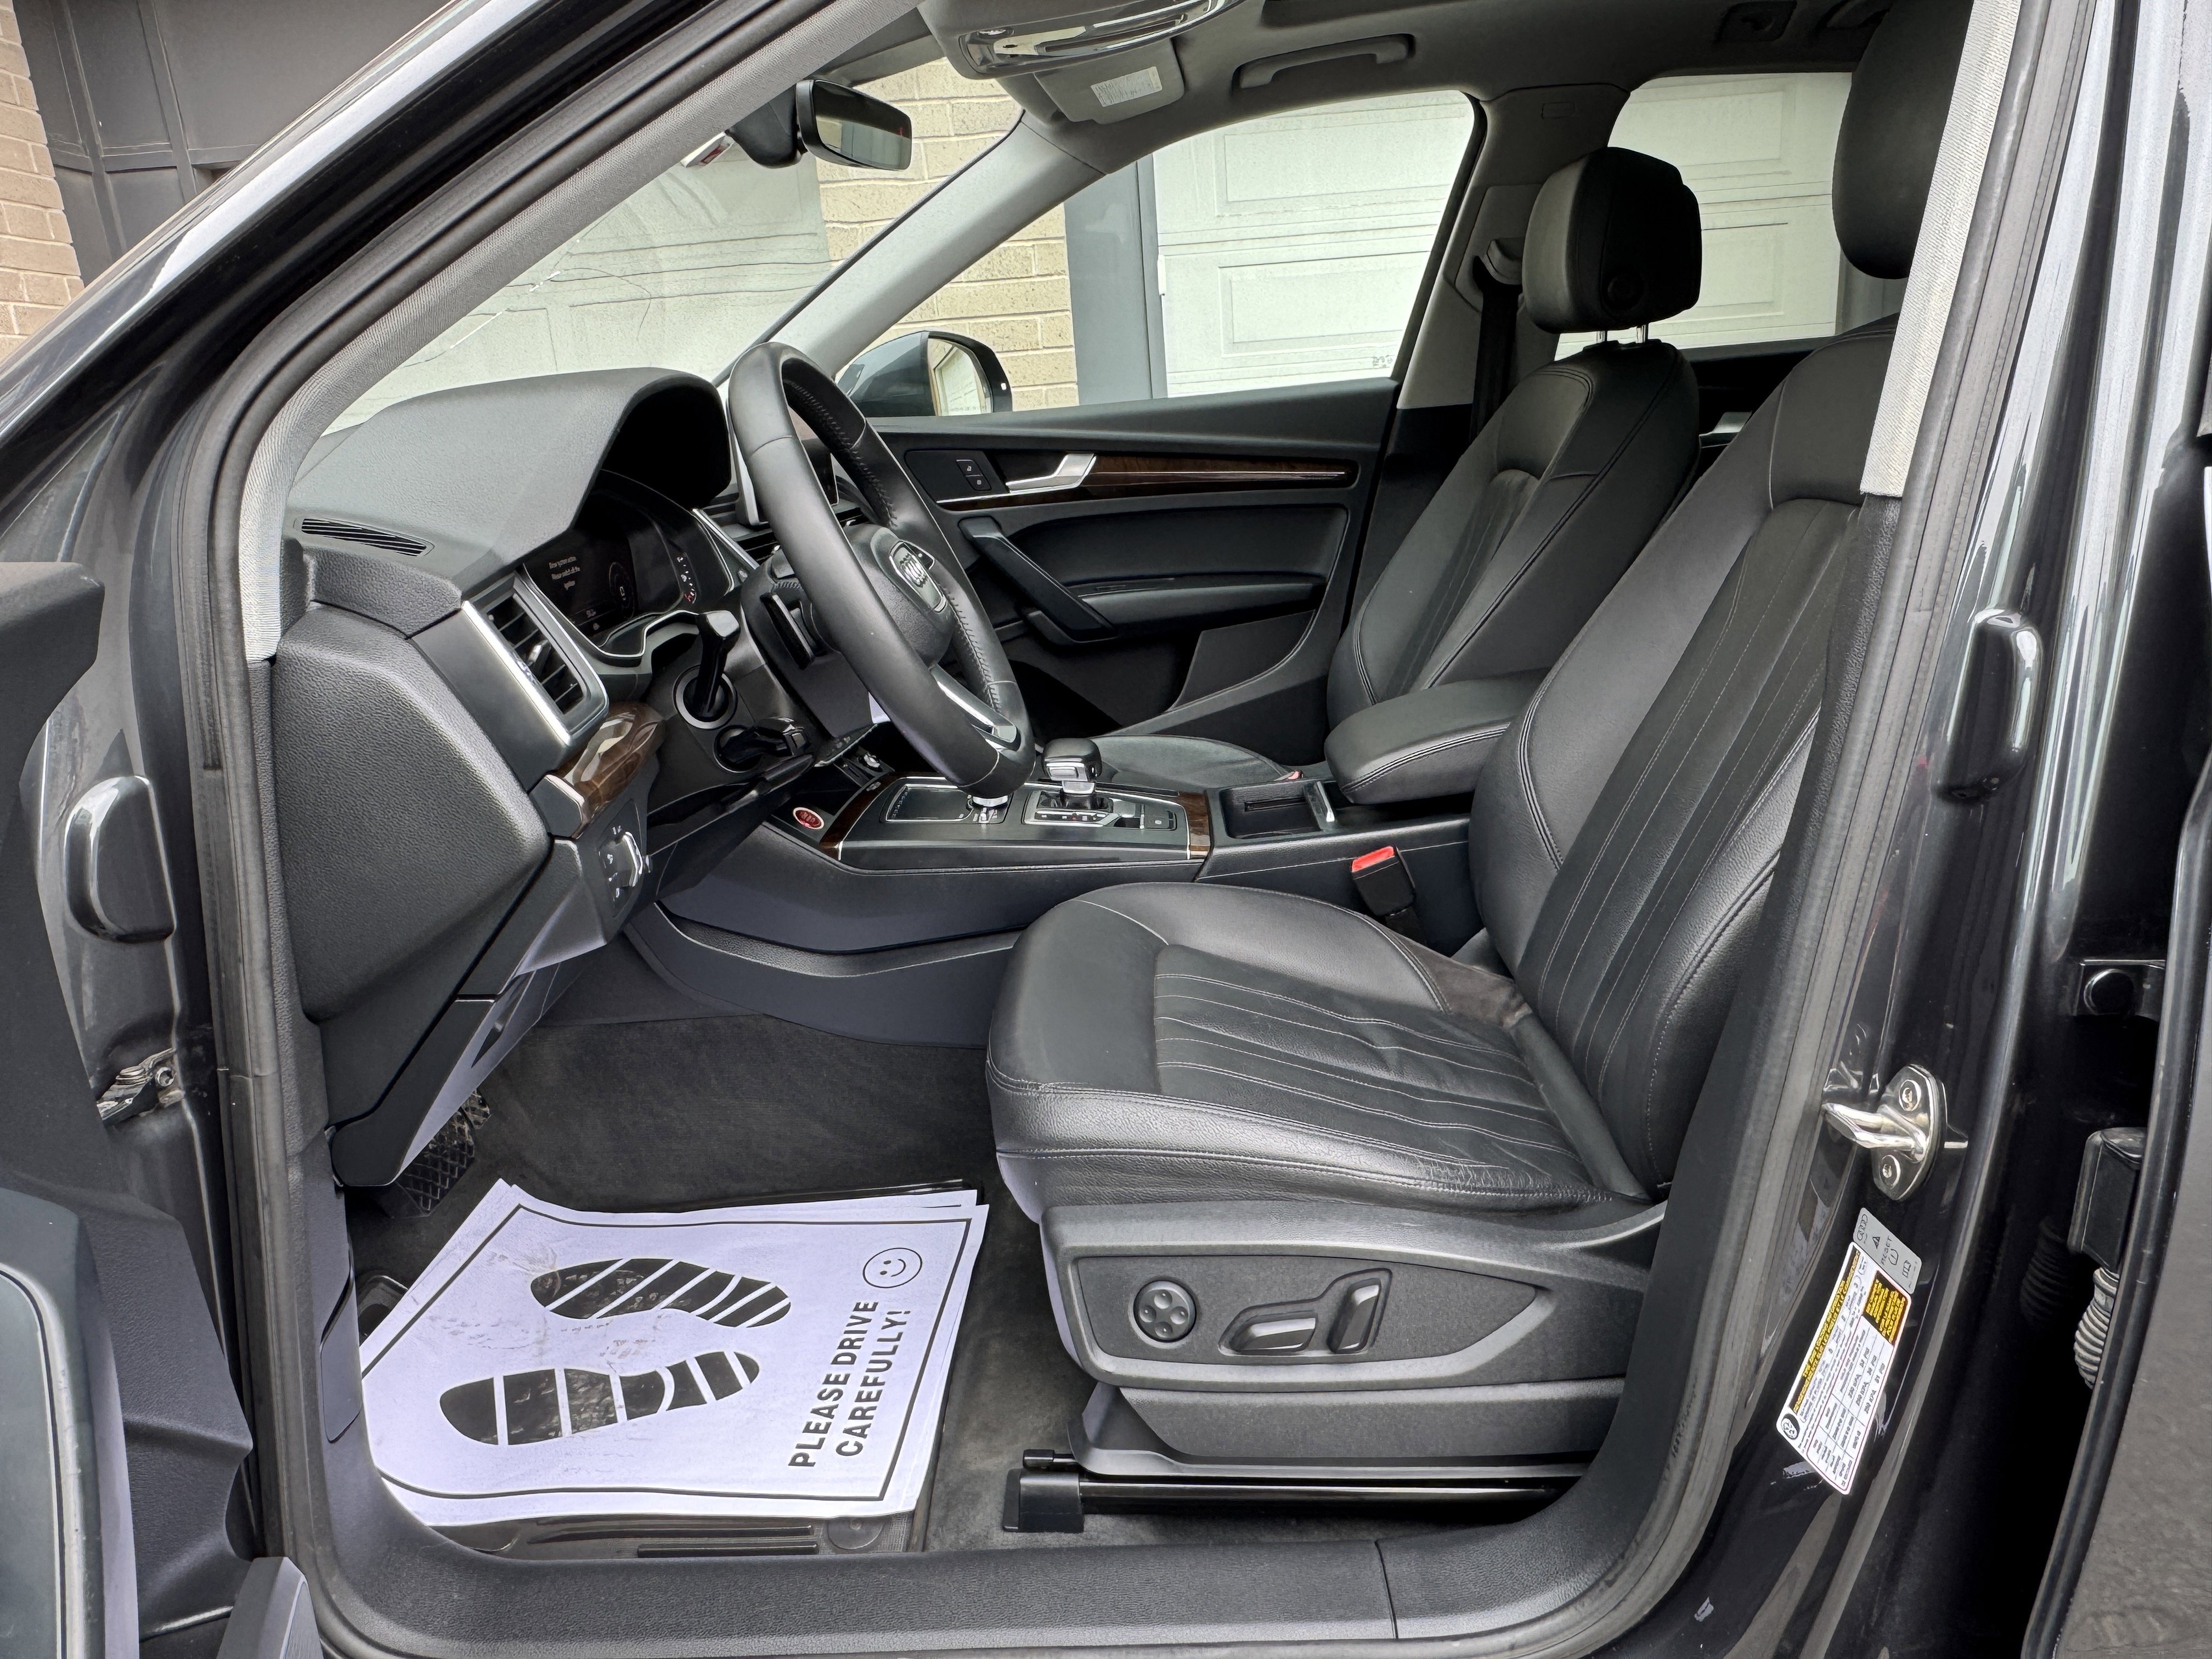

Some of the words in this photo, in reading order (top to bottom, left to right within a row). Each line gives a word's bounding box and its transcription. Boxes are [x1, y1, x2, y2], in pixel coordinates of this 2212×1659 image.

[788, 1373, 850, 1467] PLEASE
[831, 1301, 879, 1365] DRIVE
[836, 1310, 911, 1457] CAREFULLY!
